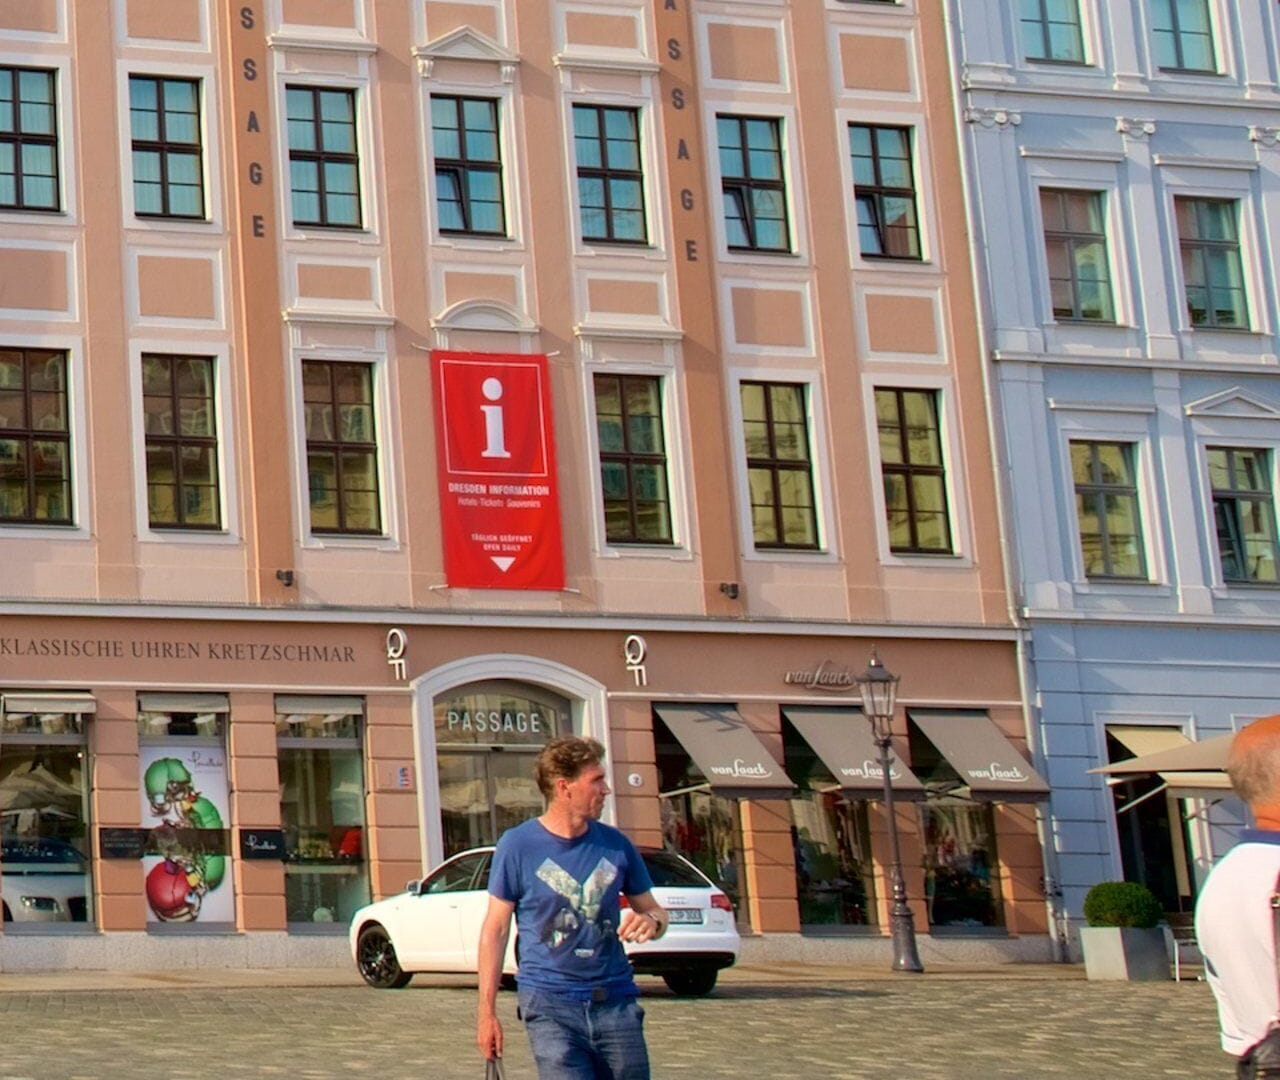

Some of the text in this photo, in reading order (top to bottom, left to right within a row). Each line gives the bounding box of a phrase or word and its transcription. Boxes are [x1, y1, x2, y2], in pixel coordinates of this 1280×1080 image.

[448, 482, 550, 497] DRESDEN INFORMATION
[0, 637, 355, 663] KLASSISCHE UHREN KRETZSCHMAR
[447, 711, 541, 733] PASSAGE
